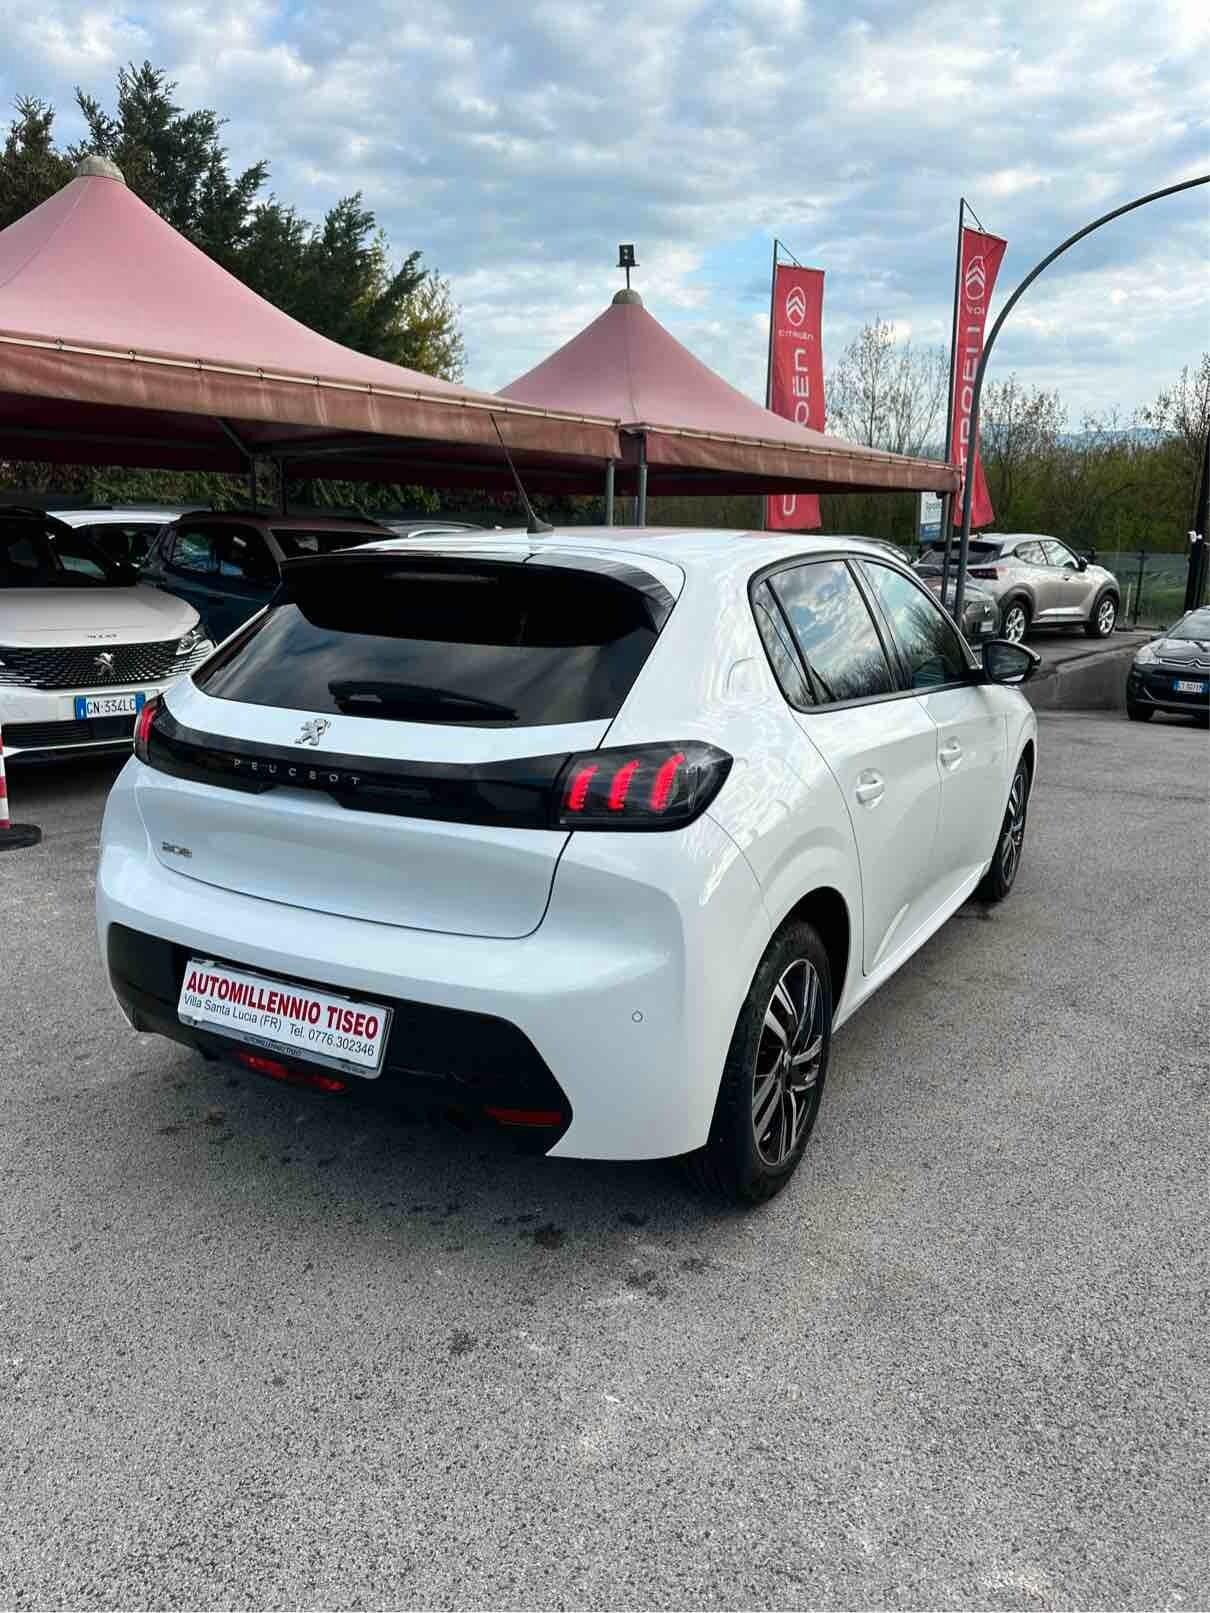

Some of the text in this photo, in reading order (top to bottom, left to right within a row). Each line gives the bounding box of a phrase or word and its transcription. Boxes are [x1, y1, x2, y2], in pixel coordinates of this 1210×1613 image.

[184, 992, 375, 1057] Villa Santa Lucia (FR) Tel. 0776.302346
[186, 971, 379, 1040] AUTOMILLENNIO TISEO
